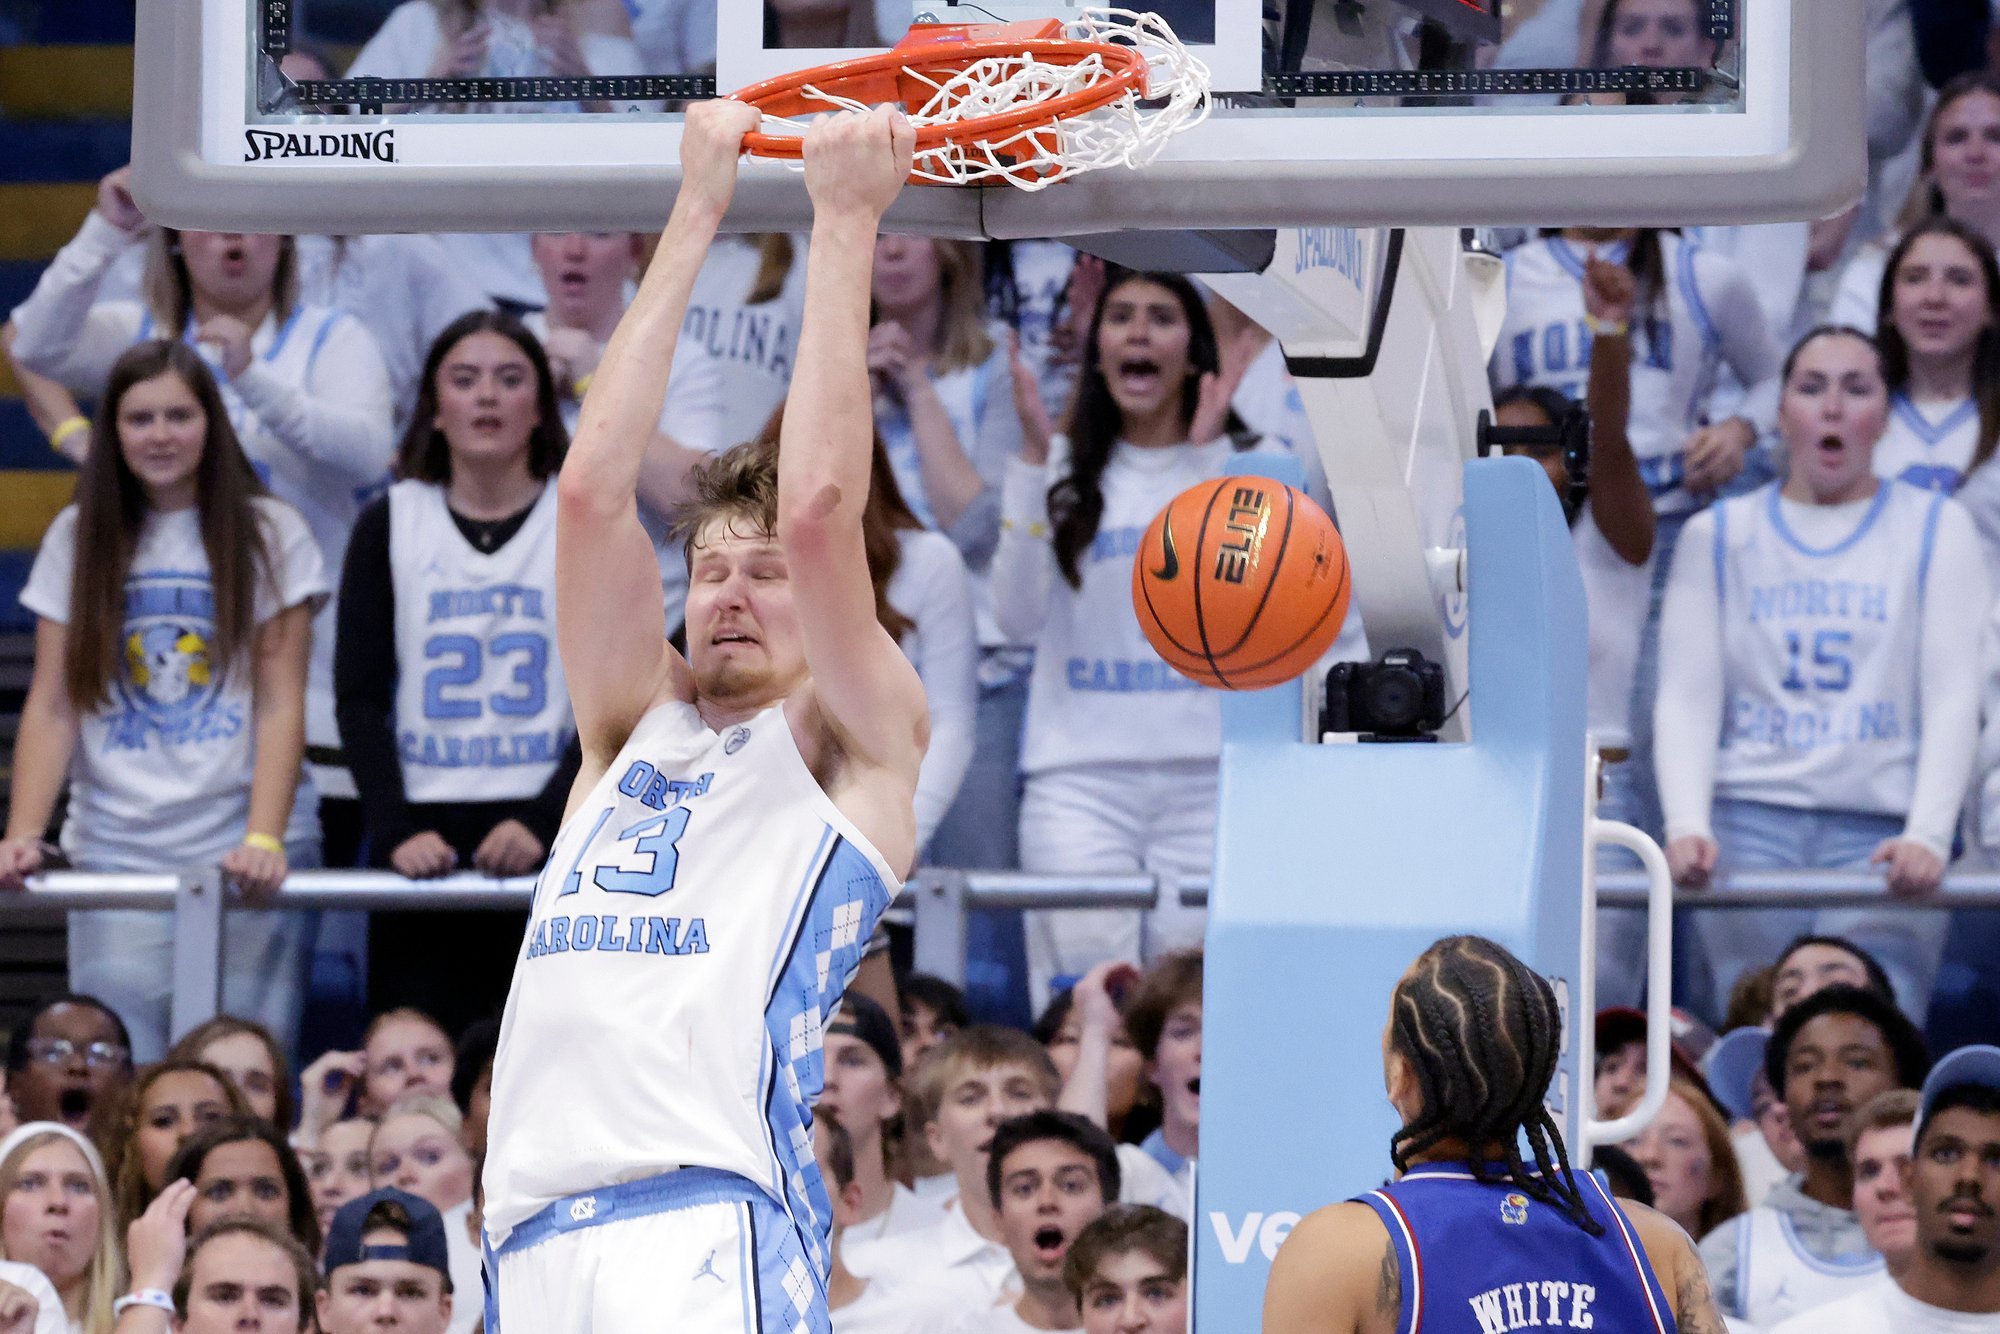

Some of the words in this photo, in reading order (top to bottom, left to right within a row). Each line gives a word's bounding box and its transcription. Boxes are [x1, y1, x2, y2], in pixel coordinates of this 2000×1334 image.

[244, 129, 395, 163] SPALDING
[683, 304, 793, 384] OLINA
[1215, 487, 1264, 584] ELITE
[424, 631, 548, 720] 23
[1067, 657, 1206, 692] CAROL
[1781, 630, 1854, 692] 15
[618, 760, 715, 811] ORTH
[526, 915, 710, 959] AROLINA
[1468, 1280, 1597, 1334] WHITE
